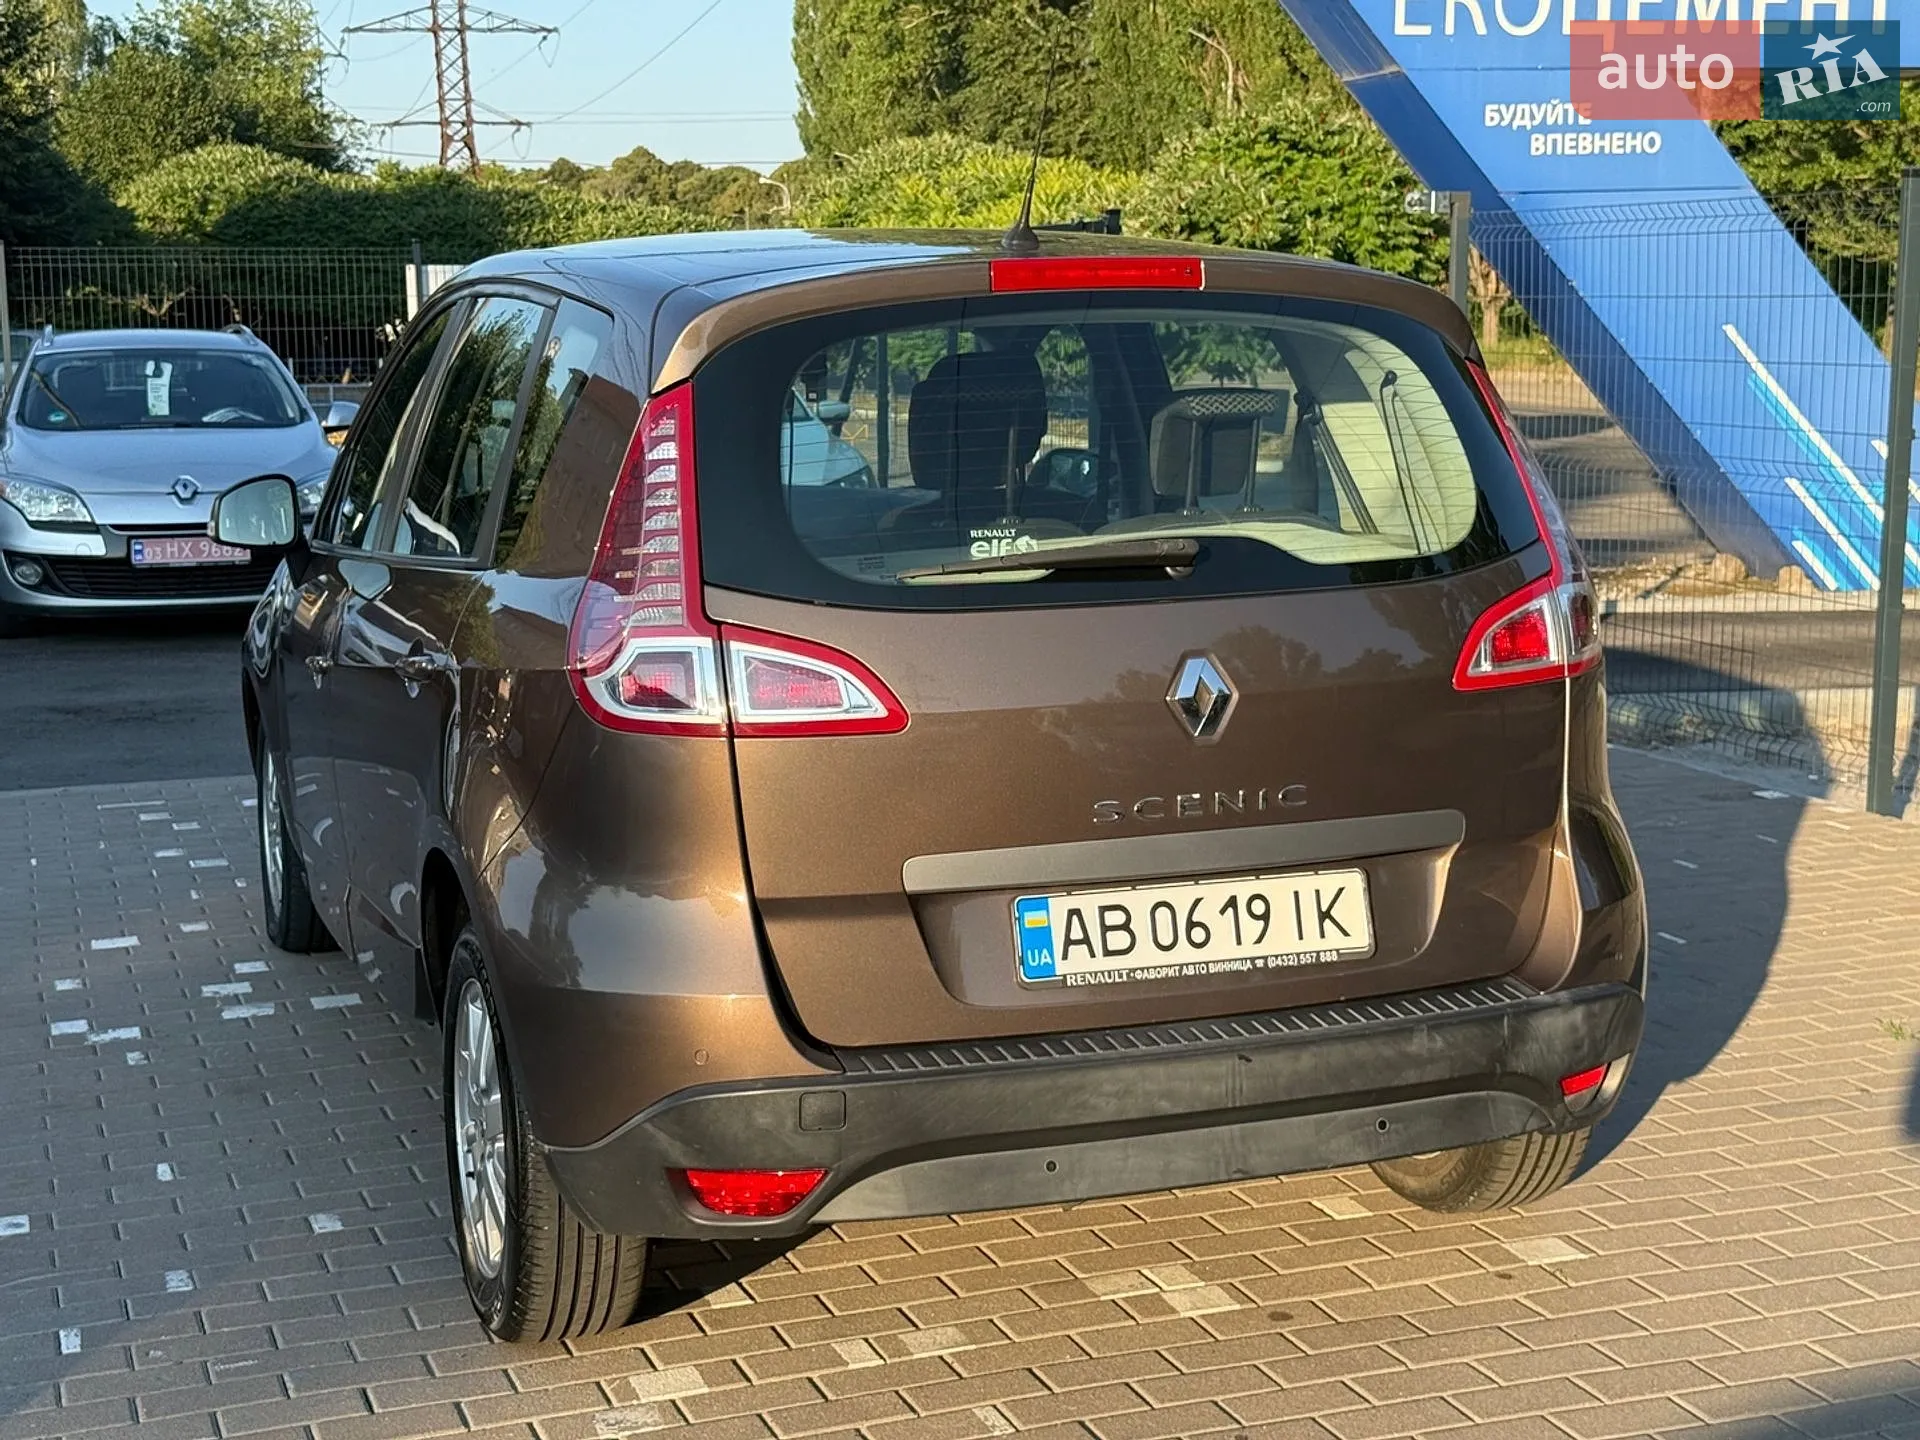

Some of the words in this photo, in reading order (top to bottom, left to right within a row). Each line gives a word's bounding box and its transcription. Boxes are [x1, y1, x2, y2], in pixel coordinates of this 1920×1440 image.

[1485, 98, 1592, 131] БУДУЙТЕ
[1530, 131, 1662, 156] ВПЕВНЕНО
[970, 528, 1016, 538] RENAULT
[970, 539, 1012, 558] elf
[1093, 784, 1308, 824] SCENIC
[1061, 904, 1137, 961] AB
[1149, 893, 1272, 952] 0619
[1293, 886, 1351, 941] IK
[1027, 948, 1053, 967] UA
[1066, 970, 1129, 987] RENAULT
[1181, 962, 1208, 976] АВТО
[1267, 953, 1299, 968] (0432)
[1300, 952, 1317, 964] 557
